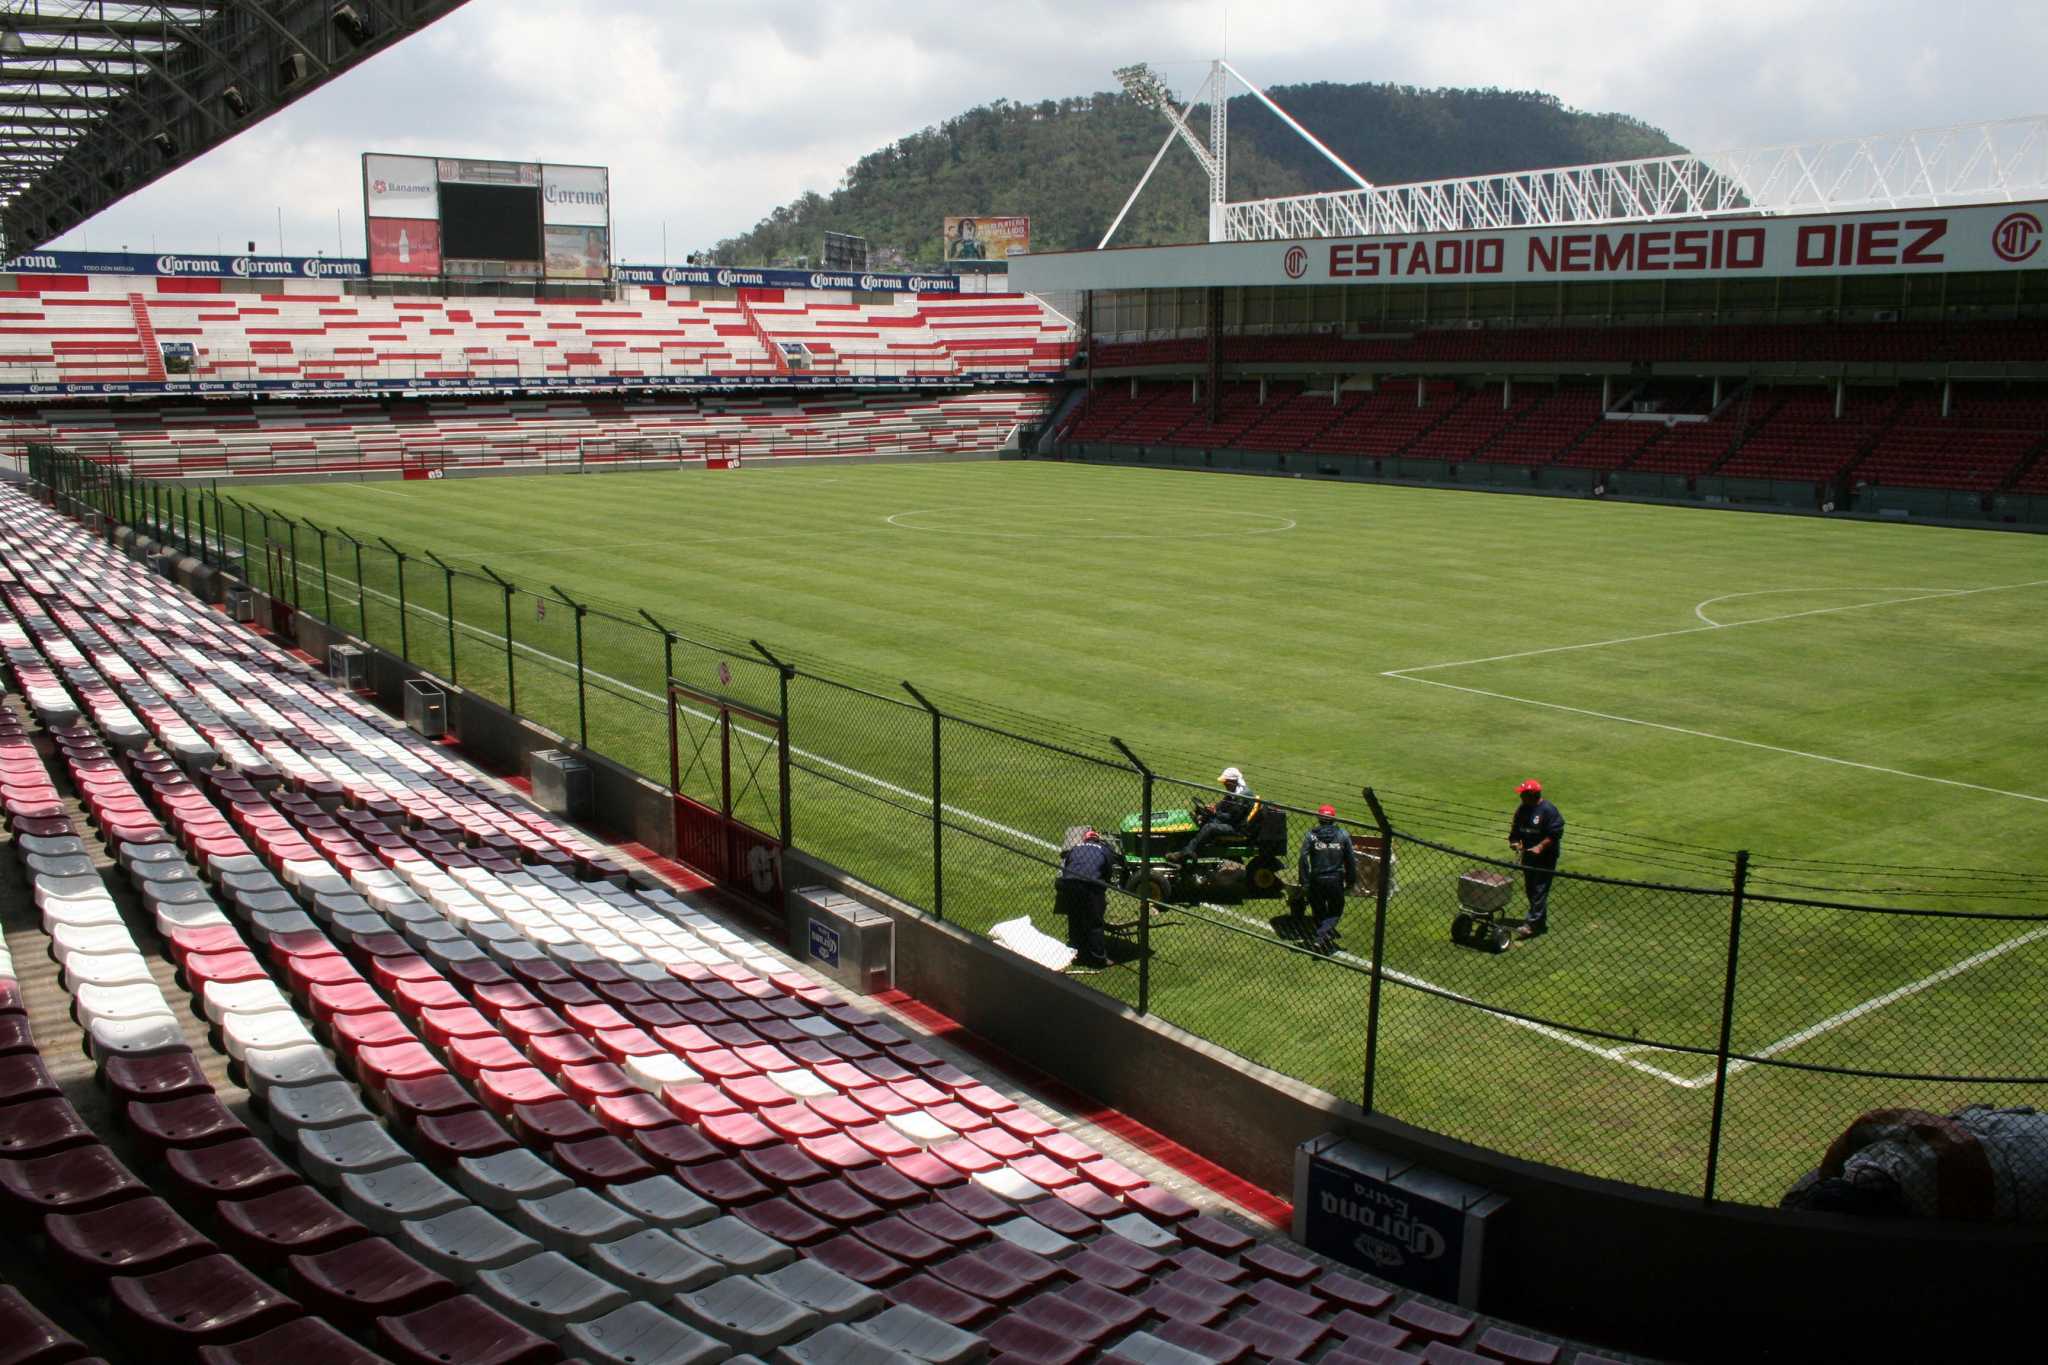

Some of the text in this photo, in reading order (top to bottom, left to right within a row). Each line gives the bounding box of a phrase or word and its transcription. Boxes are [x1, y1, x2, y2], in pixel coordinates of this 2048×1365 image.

[388, 182, 431, 193] Banamex
[545, 184, 605, 206] Corona
[1329, 218, 1948, 277] ESTADIO NEMESIO DIEZ
[0, 253, 57, 272] orona
[156, 256, 220, 275] Corona
[232, 257, 293, 278] Corona
[303, 259, 361, 279] Corona
[662, 268, 709, 285] Corona
[717, 270, 763, 286] Corona
[810, 273, 853, 289] Corona
[860, 275, 902, 291] Corona
[1321, 1190, 1446, 1260] Corona
